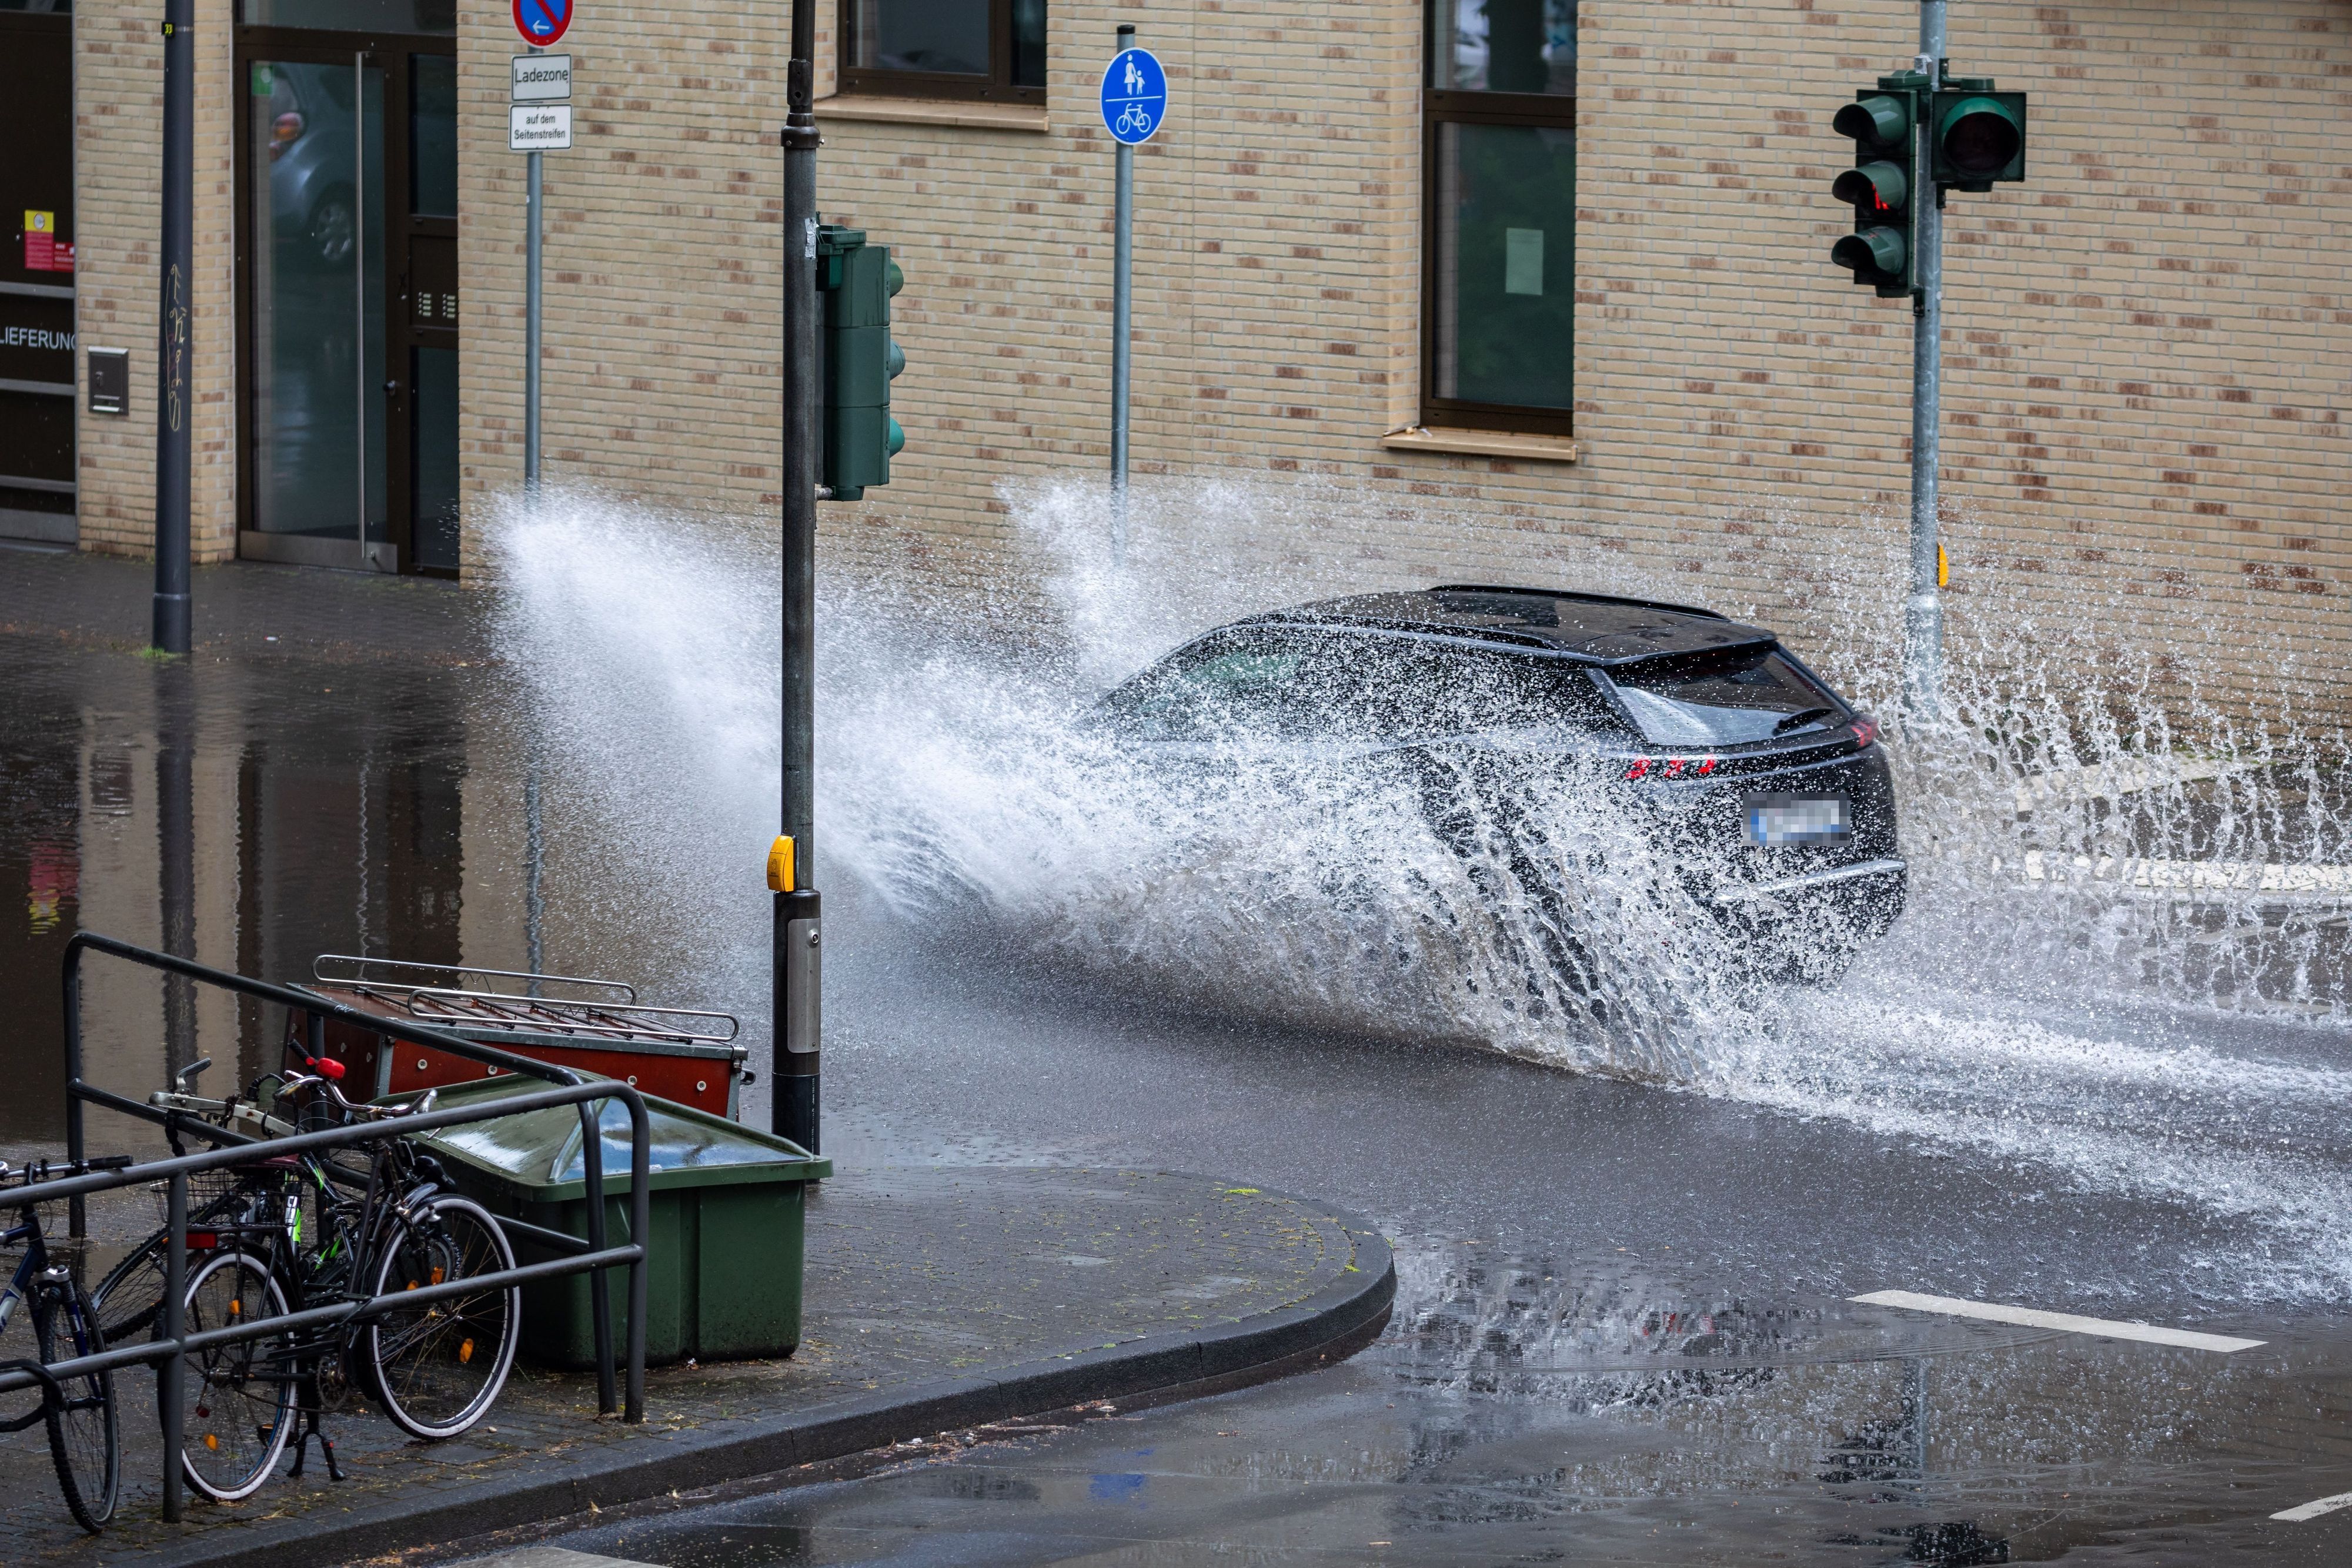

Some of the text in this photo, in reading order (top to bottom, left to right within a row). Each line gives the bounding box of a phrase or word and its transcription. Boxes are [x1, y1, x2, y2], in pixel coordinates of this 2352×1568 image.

[515, 68, 568, 82] Ladezone
[526, 113, 556, 124] auf dem
[514, 128, 566, 139] Seitenstreifen
